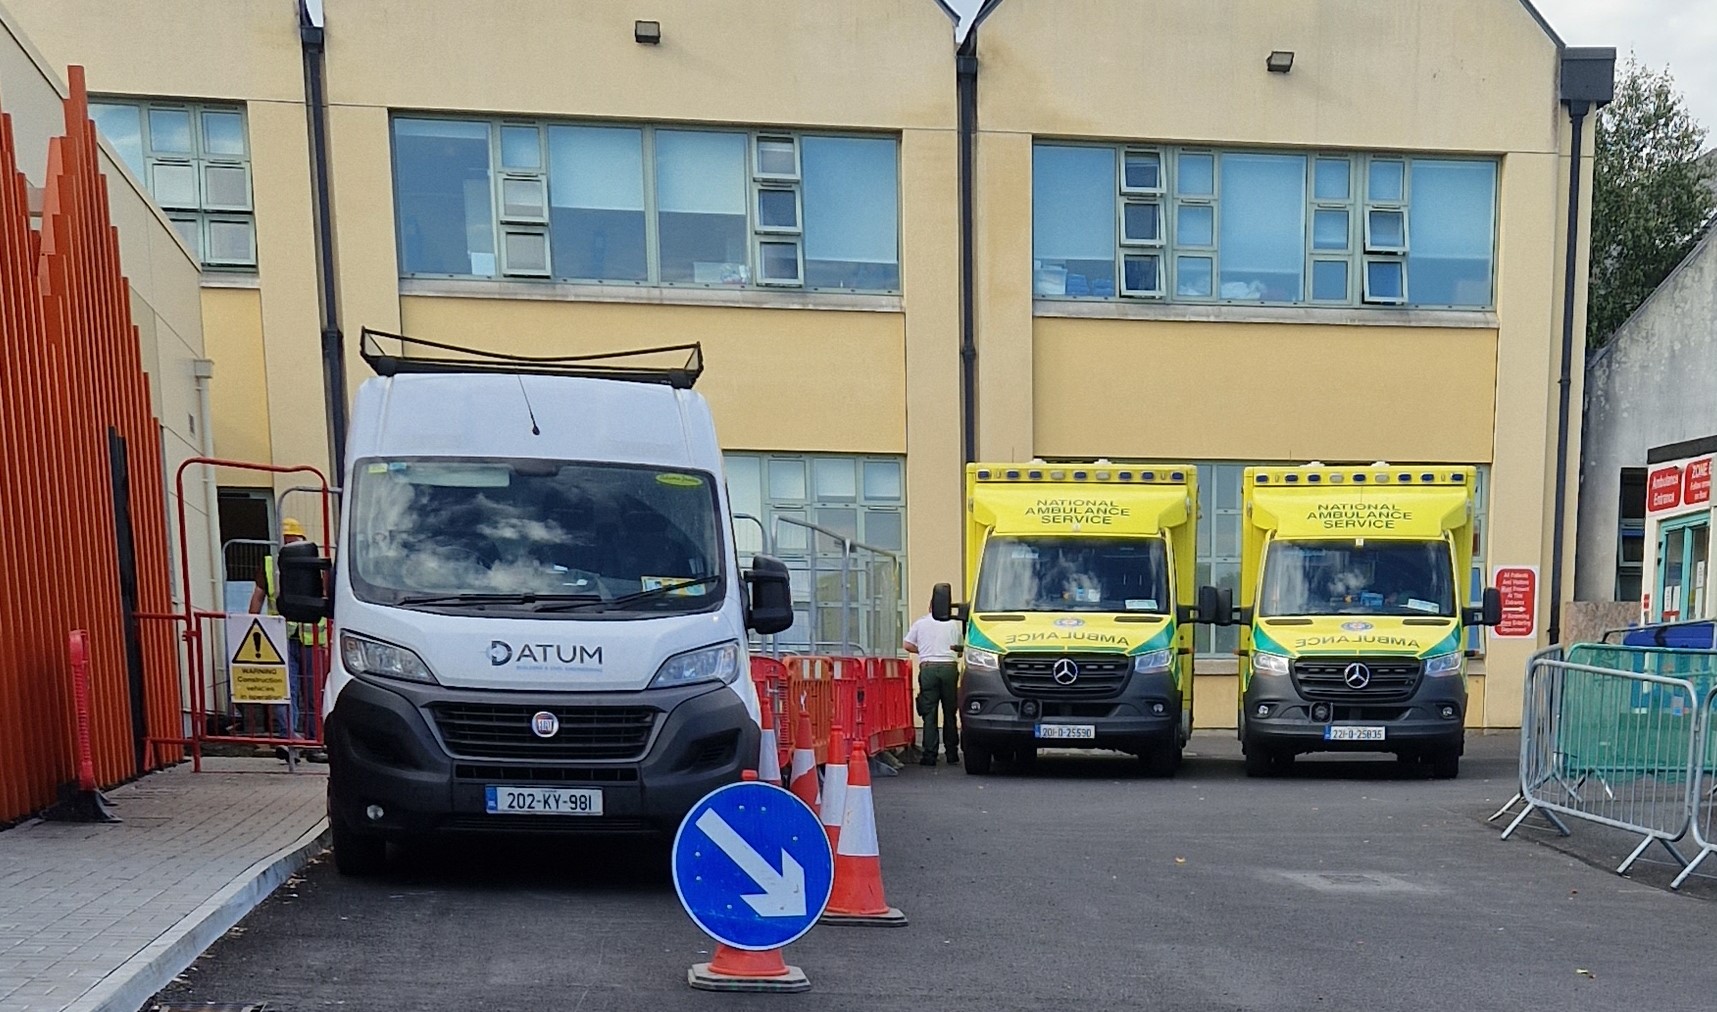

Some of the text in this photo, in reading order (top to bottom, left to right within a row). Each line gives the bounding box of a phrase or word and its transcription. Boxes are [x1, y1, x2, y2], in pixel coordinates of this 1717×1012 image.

[1037, 499, 1118, 508] NATIONAL
[1653, 492, 1675, 506] Entrance
[1024, 507, 1131, 517] AMBULANCE
[1317, 503, 1401, 511] NATIONAL
[1041, 515, 1112, 525] SERVICE
[1306, 511, 1412, 520] AMBULANCE
[1323, 519, 1396, 529] SERVICE
[491, 640, 603, 666] DATUM
[1042, 727, 1092, 738] 201-D-25590
[507, 792, 592, 811] 202-KY-981
